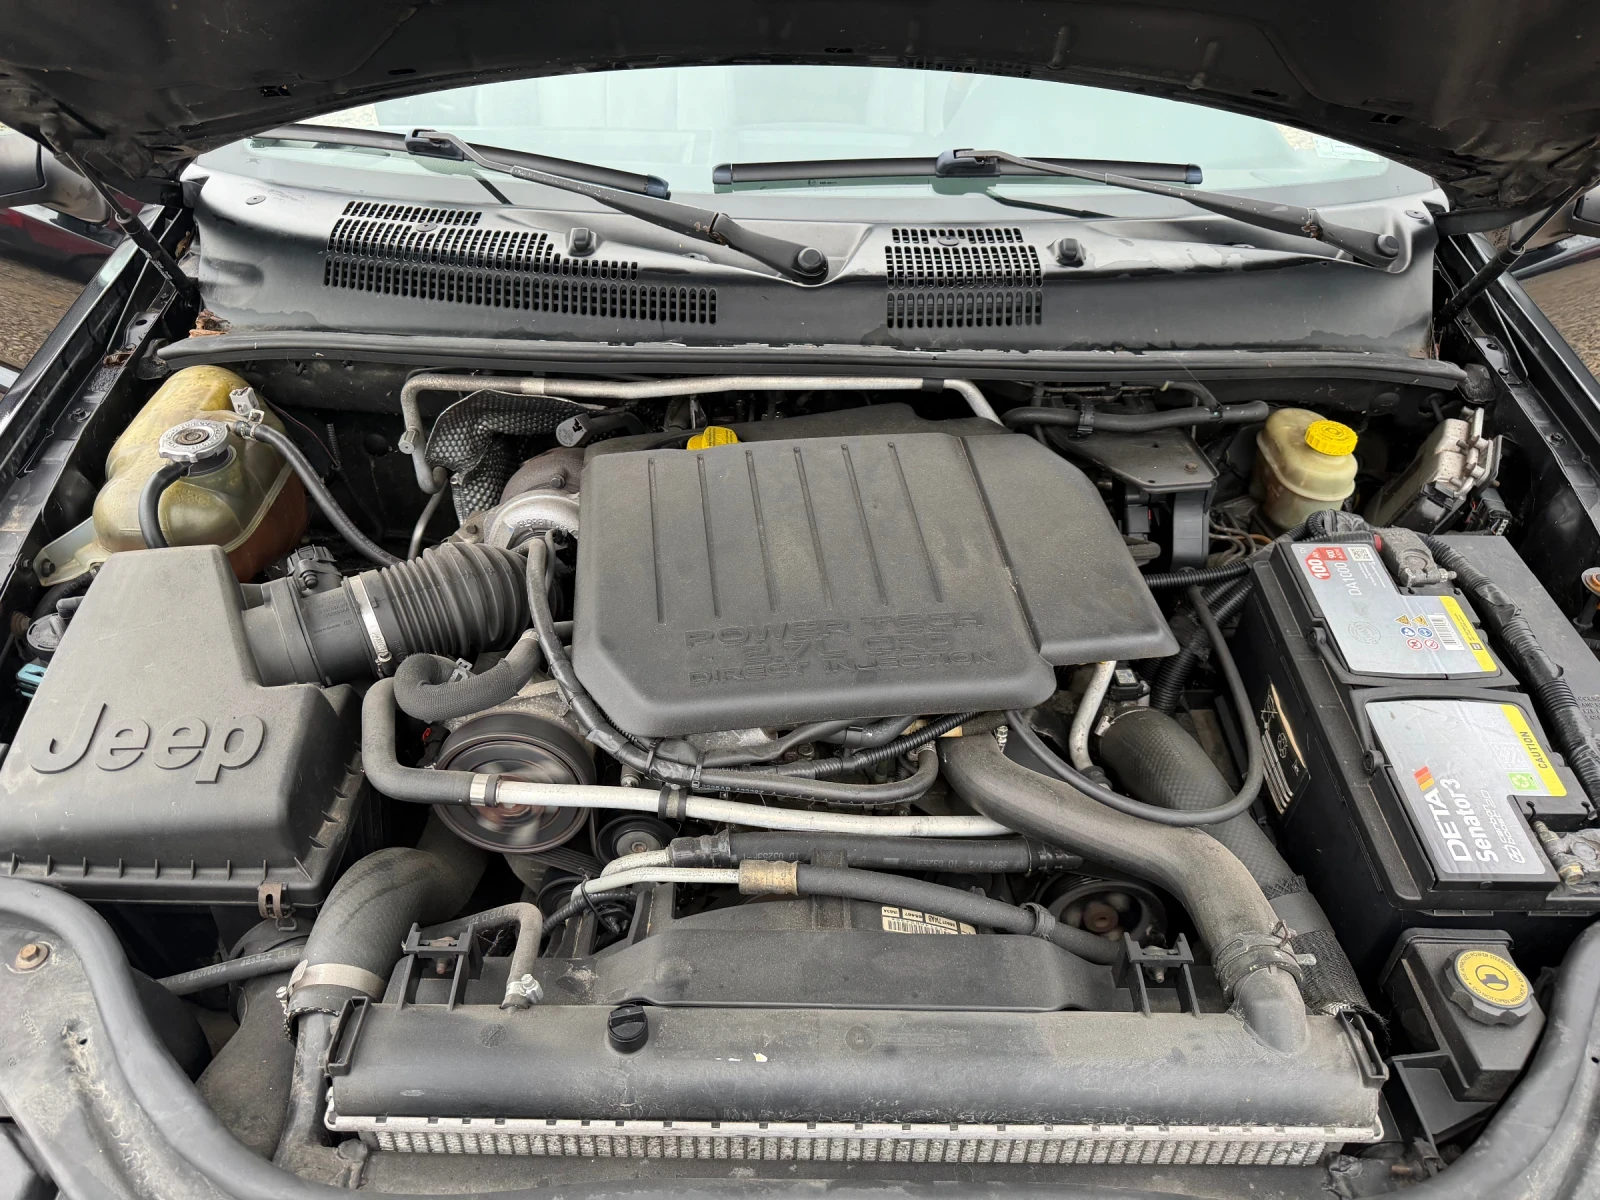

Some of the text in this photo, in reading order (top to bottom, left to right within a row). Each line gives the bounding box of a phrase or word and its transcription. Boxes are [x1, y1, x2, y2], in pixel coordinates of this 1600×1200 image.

[1307, 558, 1331, 579] 100
[1333, 561, 1364, 596] DA1000
[684, 611, 986, 648] POWER TECH
[862, 633, 953, 656] CRD
[688, 650, 998, 688] DIRECT INJECTION
[26, 700, 268, 785] Jeep
[1519, 730, 1548, 770] CAUTION
[1423, 787, 1474, 863] DETA
[1439, 778, 1499, 864] Senator3
